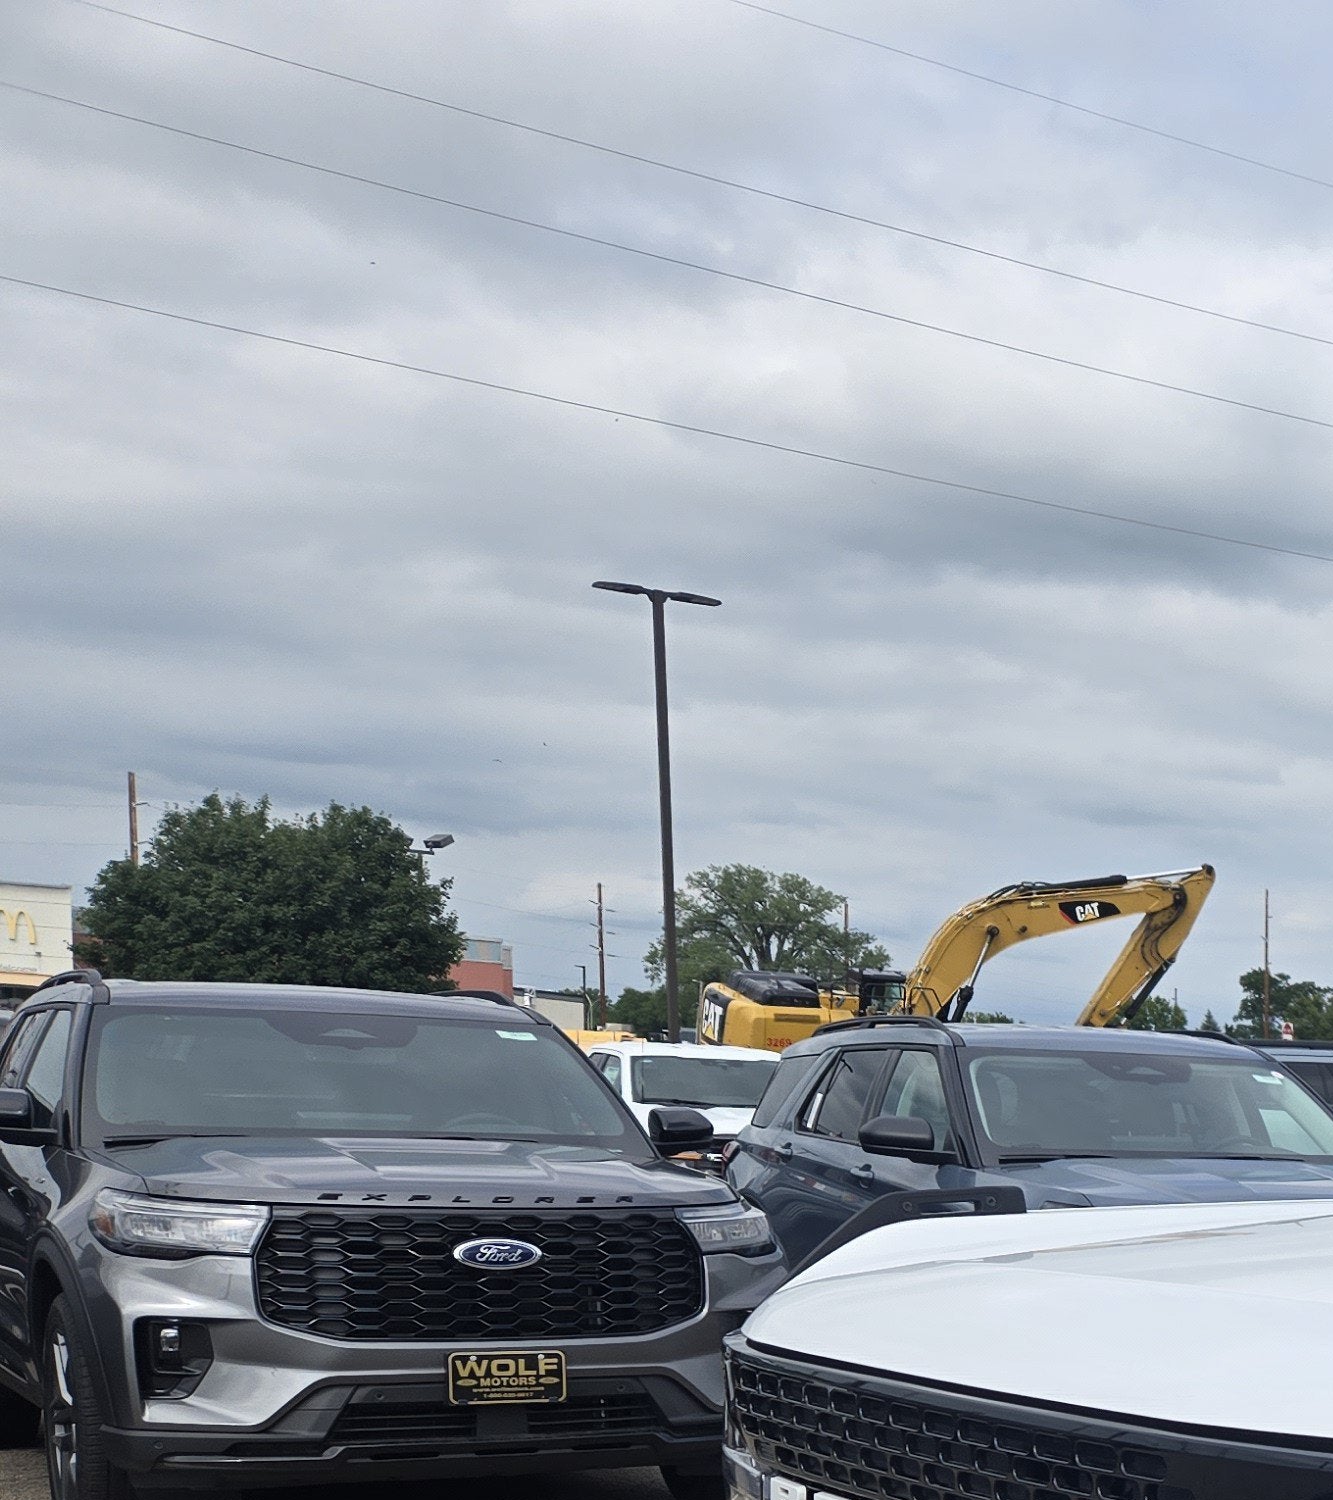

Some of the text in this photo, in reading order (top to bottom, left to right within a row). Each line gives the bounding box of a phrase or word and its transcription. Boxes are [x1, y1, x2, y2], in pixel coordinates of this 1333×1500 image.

[1075, 901, 1100, 922] CAT
[702, 998, 724, 1041] CAT
[317, 1192, 634, 1204] EXPLORER
[475, 1244, 522, 1262] Ford
[455, 1358, 559, 1377] WOLF
[480, 1377, 537, 1387] MOTORS
